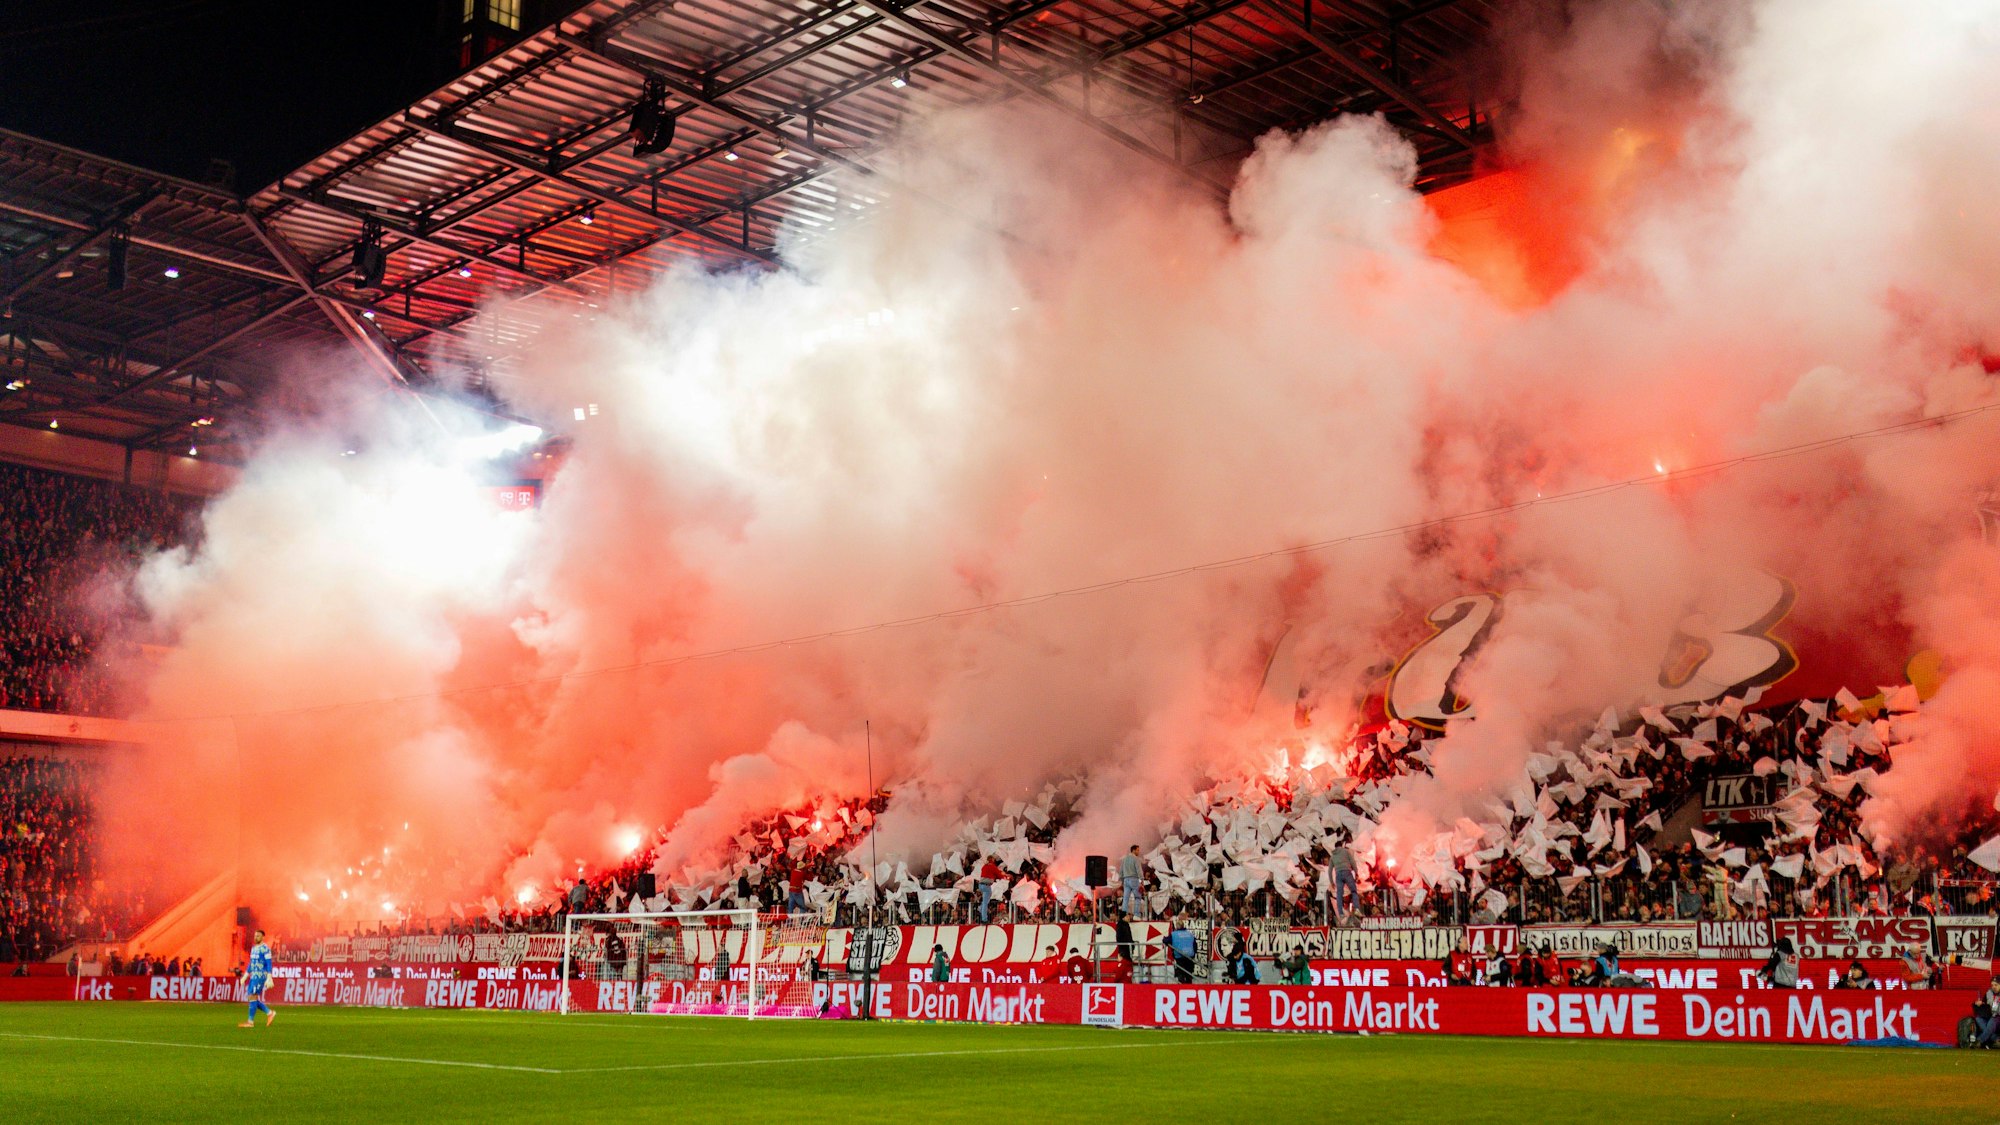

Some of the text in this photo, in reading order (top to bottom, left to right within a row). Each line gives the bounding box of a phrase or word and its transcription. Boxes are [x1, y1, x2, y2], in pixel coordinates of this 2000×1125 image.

[1704, 777, 1747, 807] LTK
[906, 923, 1172, 964] HORDE
[1612, 930, 1693, 952] Mythos
[1700, 921, 1769, 947] RAFIKIS
[1775, 919, 1930, 945] FREAKS
[1946, 928, 1980, 952] FC
[150, 976, 204, 1000] REWE
[208, 977, 231, 1001] Dein
[284, 978, 405, 1007] REWE Dein Markt
[1405, 969, 1448, 988] Dei
[425, 979, 478, 1007] REWE
[485, 980, 519, 1009] Dein
[813, 983, 1045, 1023] REWE Dein Markt
[1154, 989, 1440, 1030] REWE Dein Markt
[1526, 993, 1920, 1041] REWE Dein Markt
